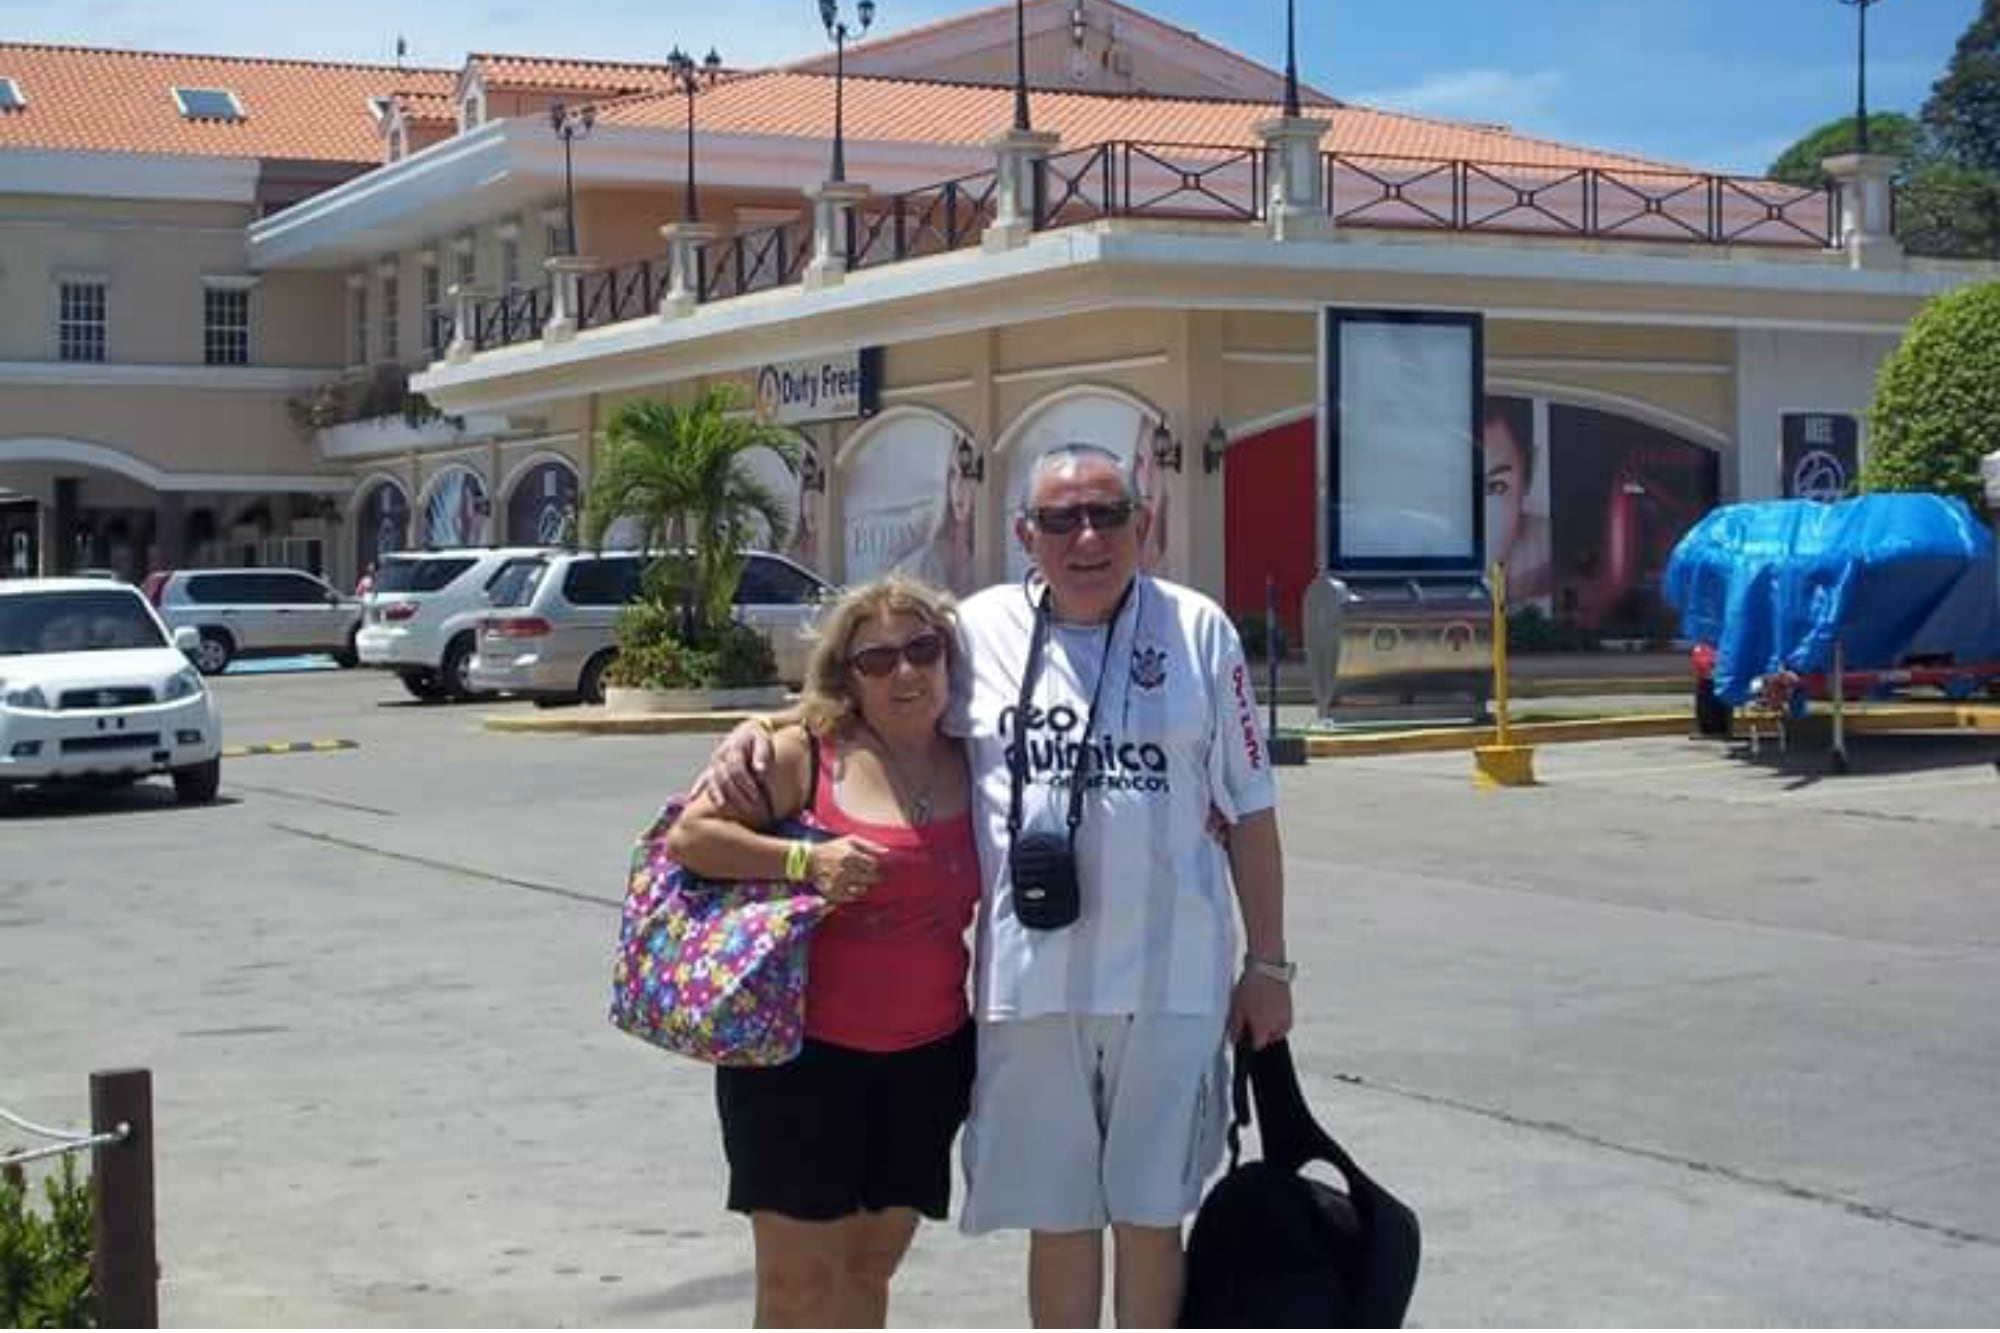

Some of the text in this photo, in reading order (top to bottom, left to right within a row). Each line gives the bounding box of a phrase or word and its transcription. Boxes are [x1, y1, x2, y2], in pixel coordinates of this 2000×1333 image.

[782, 364, 859, 408] Duty Free
[998, 706, 1077, 736] neo
